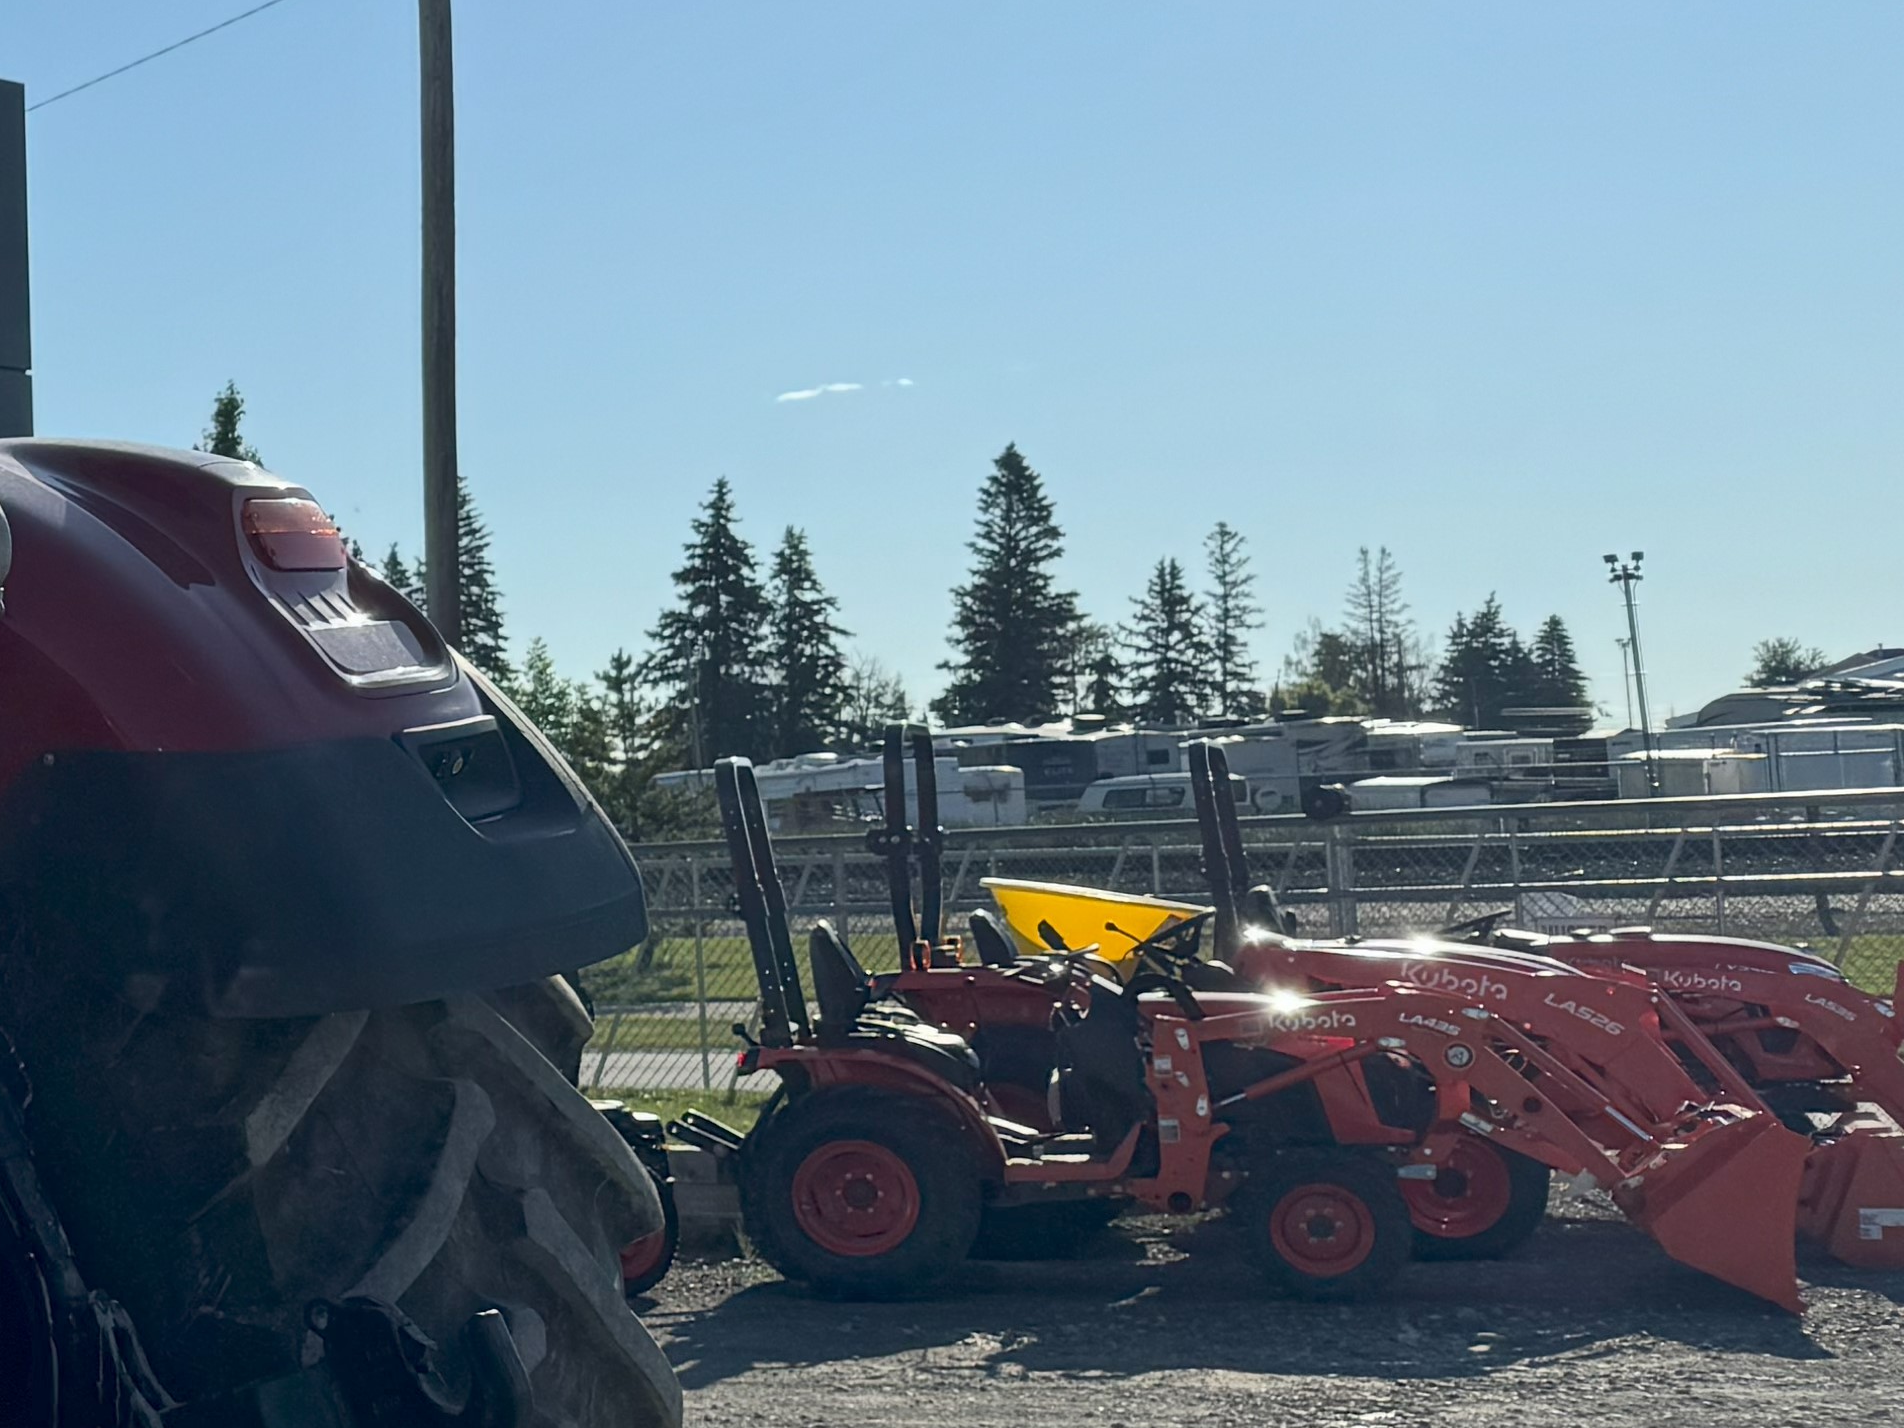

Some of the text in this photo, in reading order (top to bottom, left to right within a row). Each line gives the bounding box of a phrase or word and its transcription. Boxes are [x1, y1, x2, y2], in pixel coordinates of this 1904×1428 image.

[1400, 961, 1508, 1001] Kubota
[1663, 969, 1743, 992] Kubota
[1268, 1009, 1356, 1033] Kubota
[1544, 992, 1625, 1036] LA526
